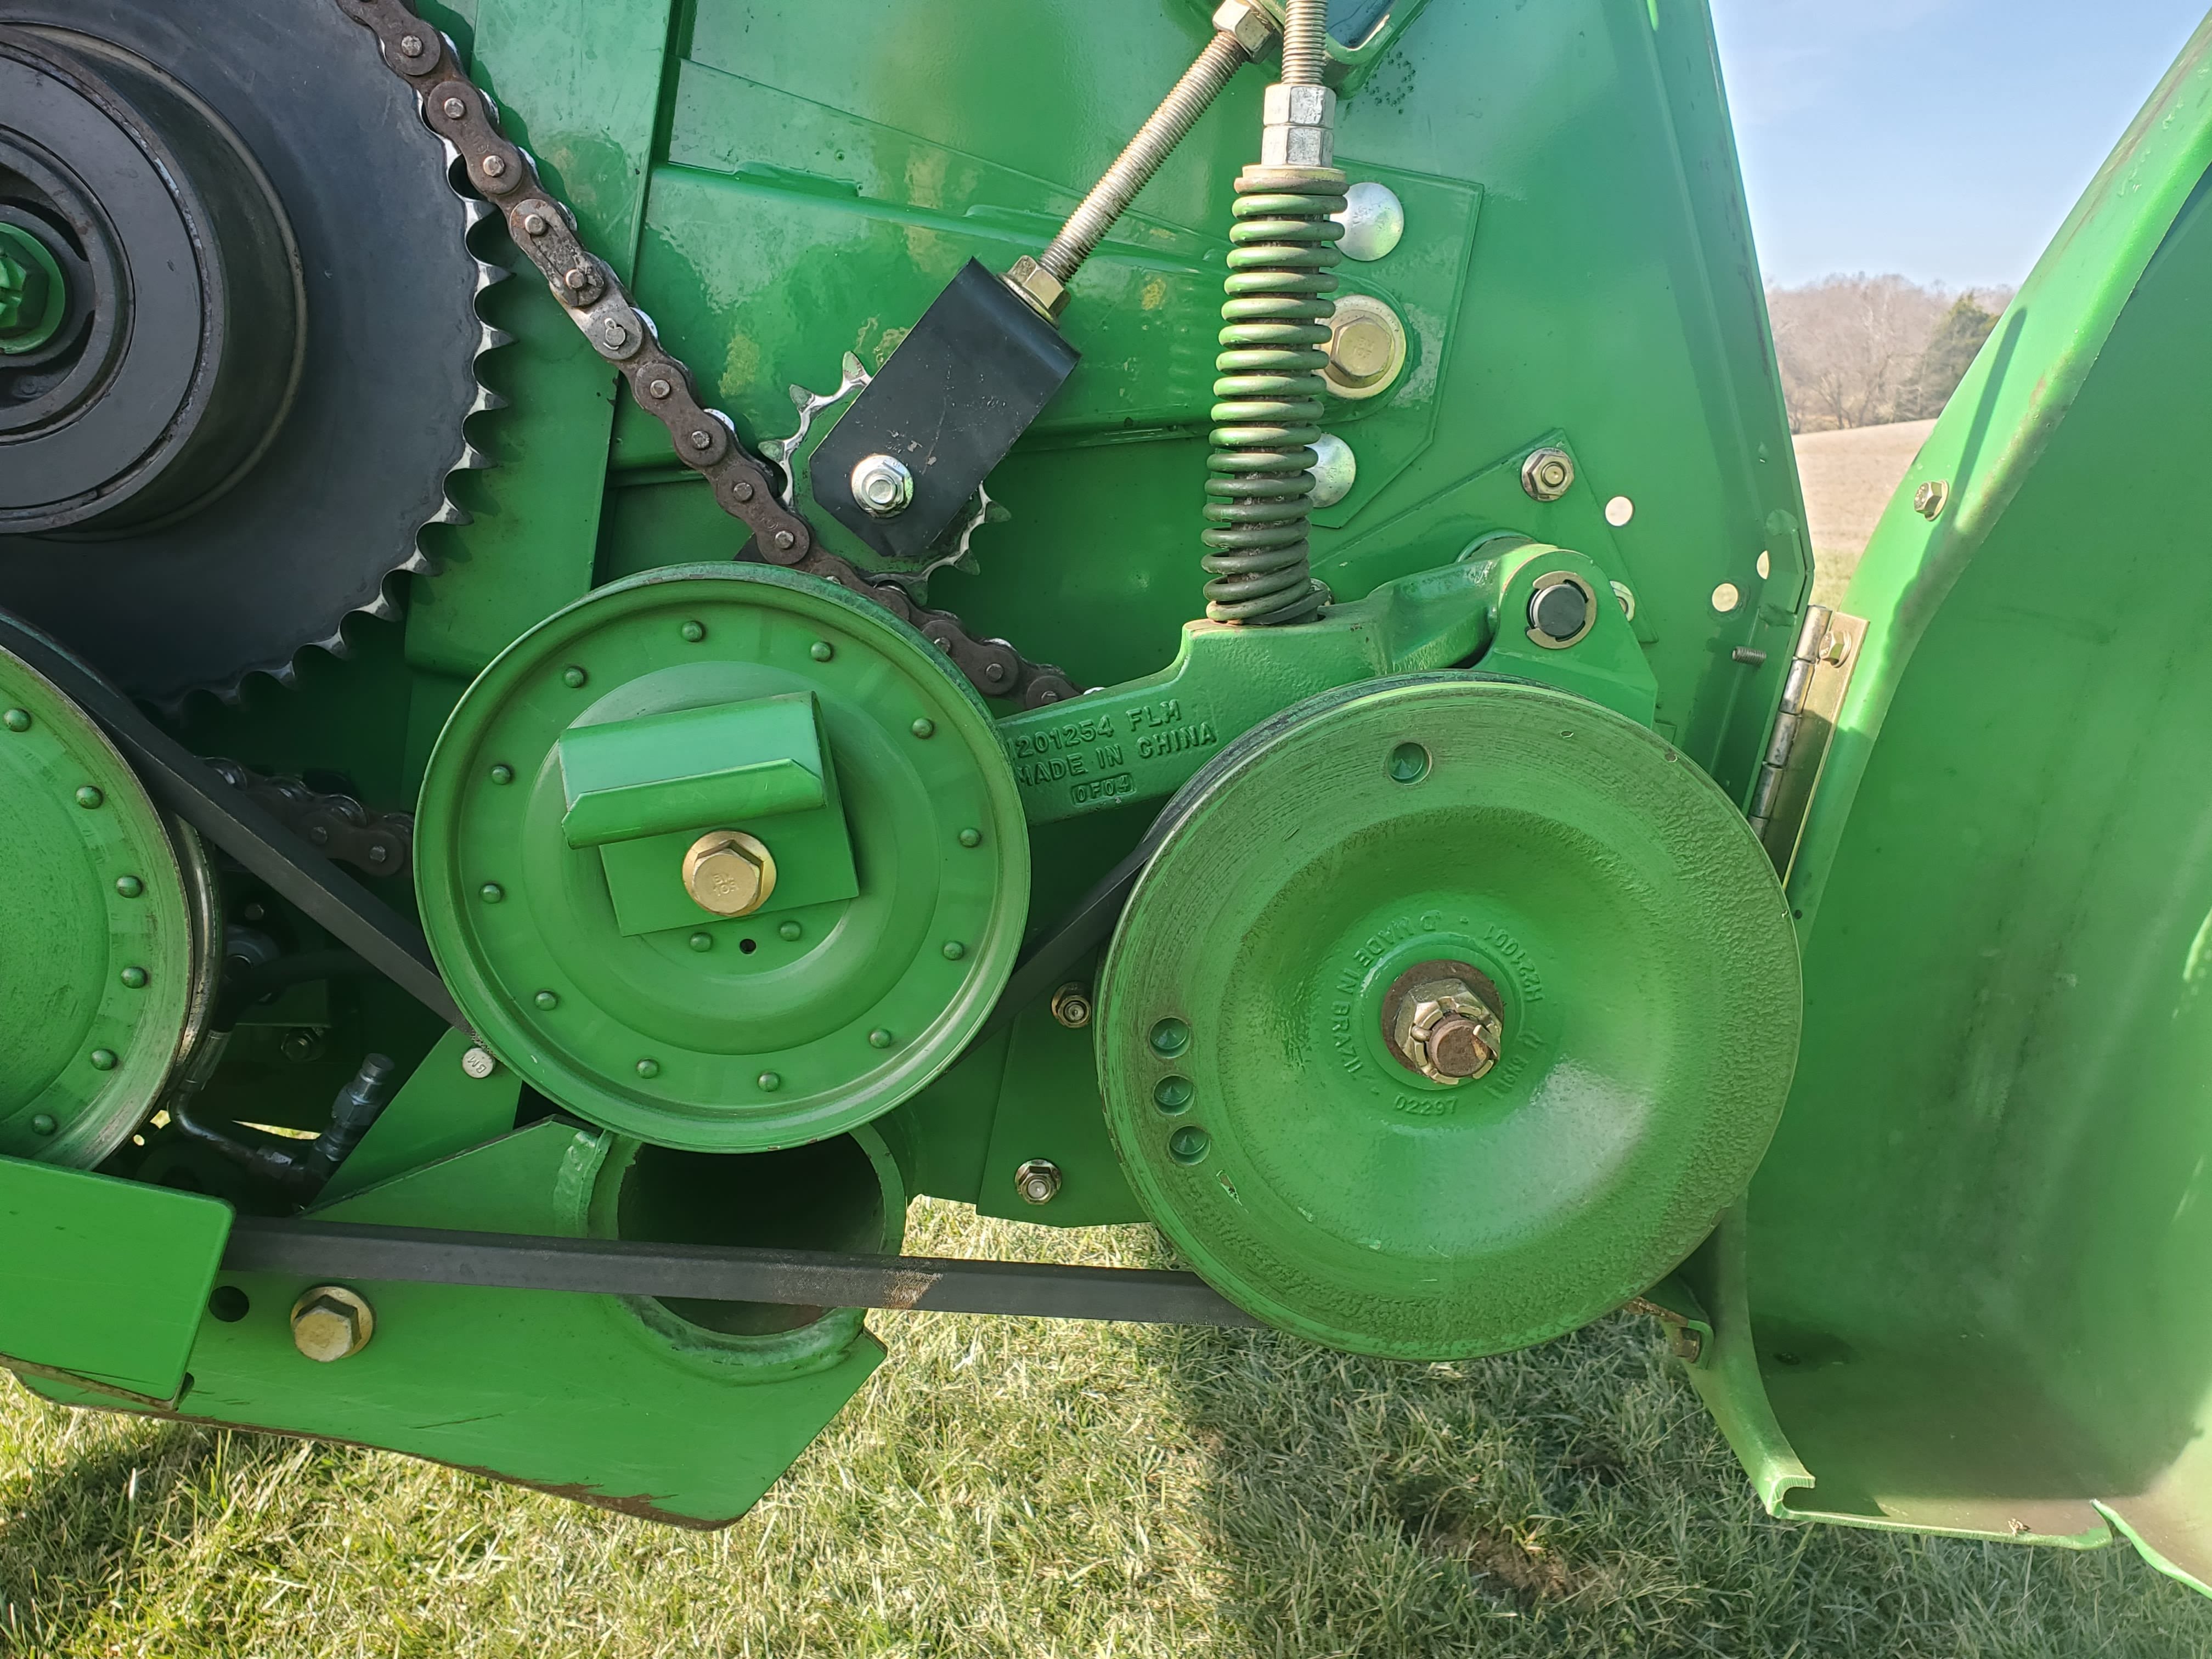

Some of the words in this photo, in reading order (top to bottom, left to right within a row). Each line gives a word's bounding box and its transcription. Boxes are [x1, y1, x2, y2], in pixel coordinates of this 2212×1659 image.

[1125, 698, 1182, 732] FLM
[1015, 752, 1088, 787] MADE
[1096, 743, 1124, 769] IN
[1137, 721, 1218, 759] CHINA
[1353, 917, 1414, 967] MADE
[1335, 967, 1361, 995] IN
[1331, 1000, 1364, 1080] BRAZIL
[467, 1056, 487, 1074] BM
